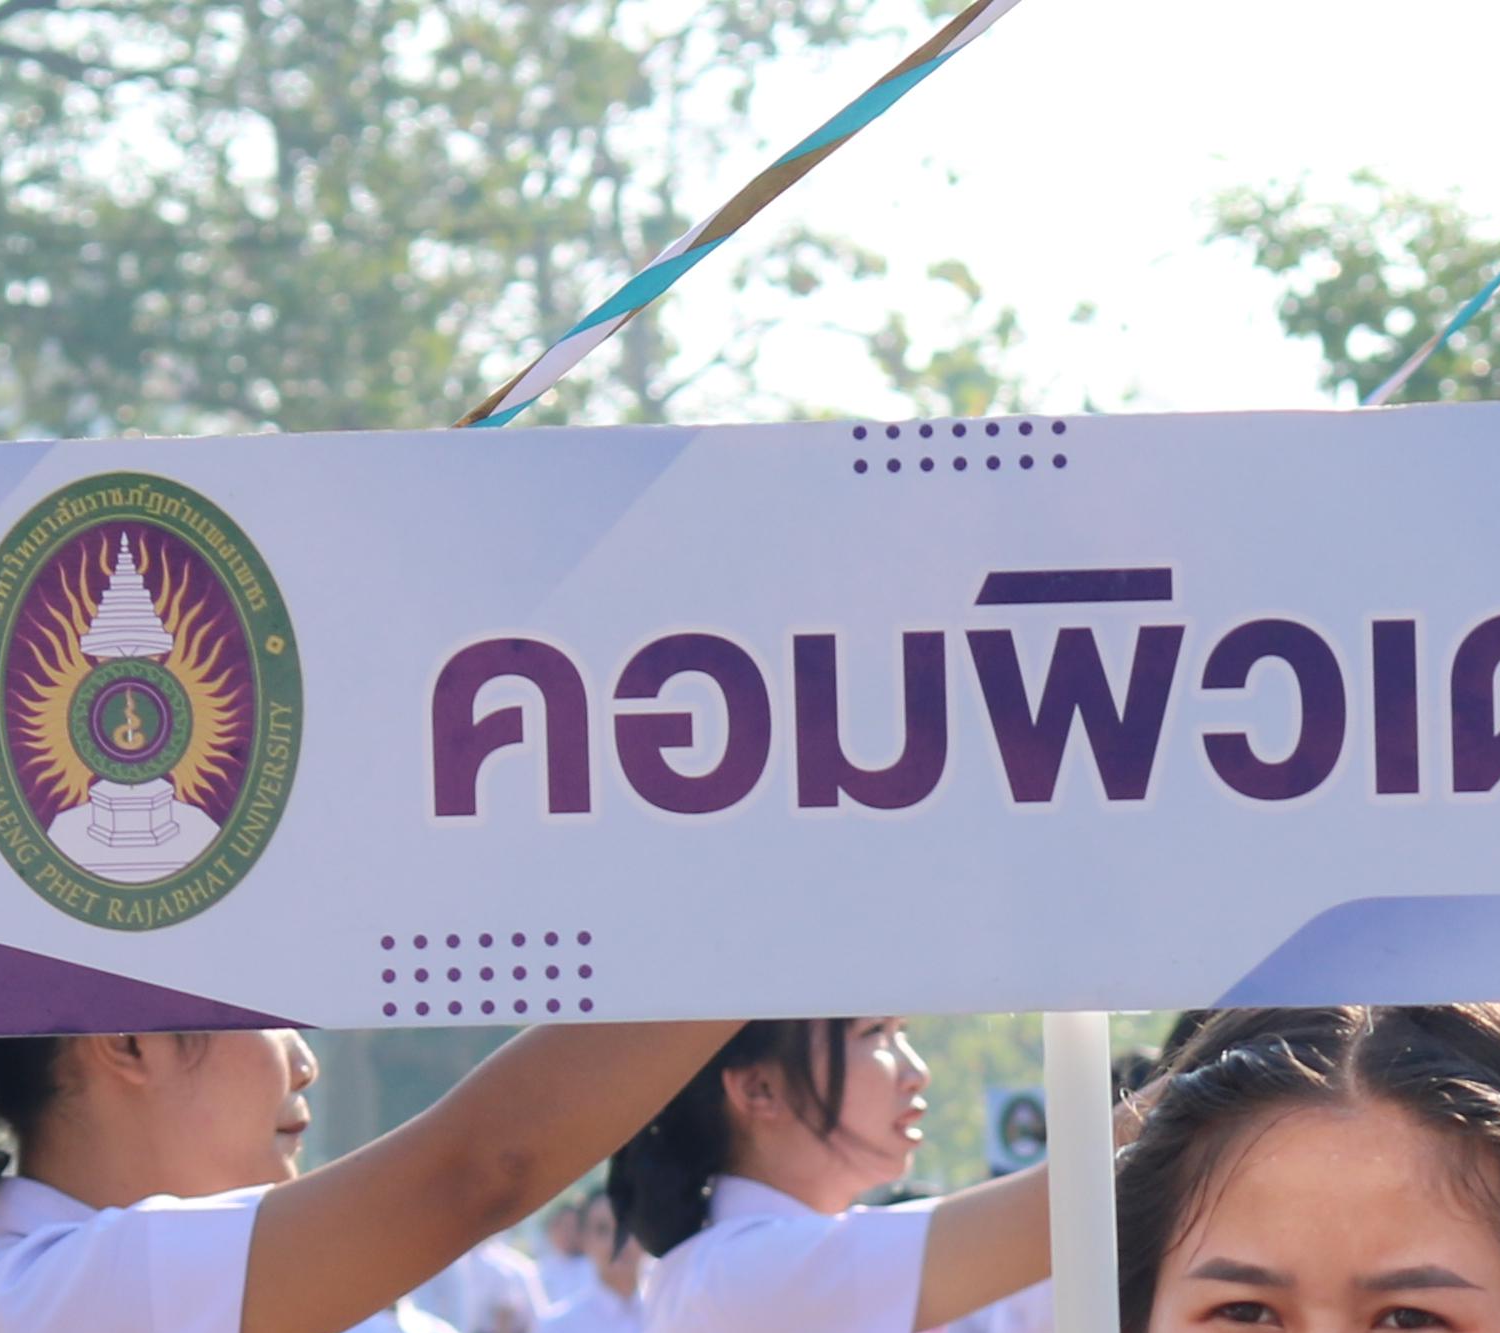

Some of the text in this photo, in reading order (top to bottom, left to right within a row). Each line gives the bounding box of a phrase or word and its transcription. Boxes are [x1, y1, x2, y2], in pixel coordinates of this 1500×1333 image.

[37, 863, 101, 915] PHET
[106, 858, 237, 927] RAJABHAT
[229, 702, 293, 857] UNIVERSITY
